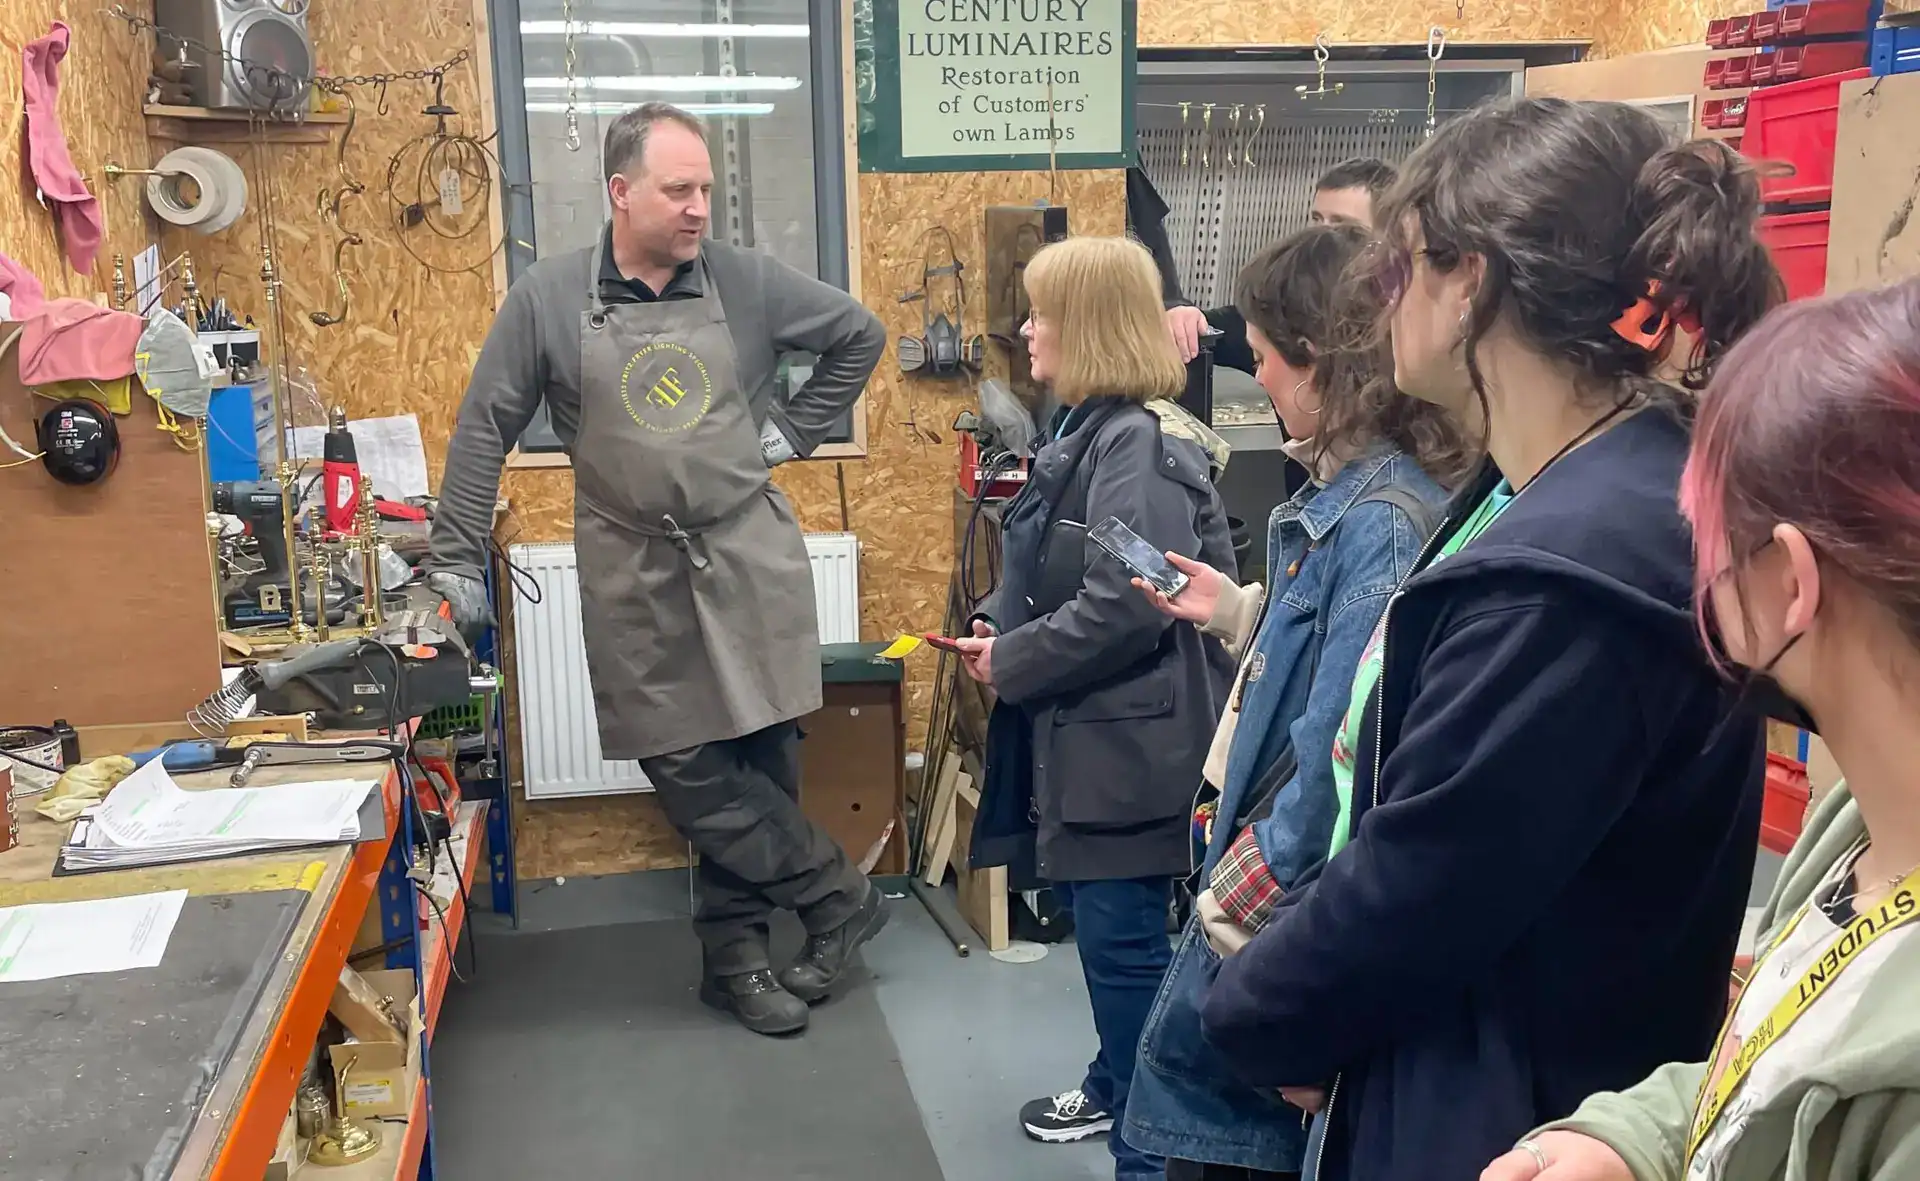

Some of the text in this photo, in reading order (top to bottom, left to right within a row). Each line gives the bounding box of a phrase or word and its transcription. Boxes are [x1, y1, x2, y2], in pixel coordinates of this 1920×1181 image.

[925, 0, 1089, 22] CENTURY
[908, 31, 1112, 56] LUMINAIRES
[941, 66, 1080, 90] Restoration
[938, 96, 963, 114] of
[953, 127, 996, 142] own
[654, 343, 688, 354] LIGHTING
[1796, 890, 1916, 1009] STUDENT
